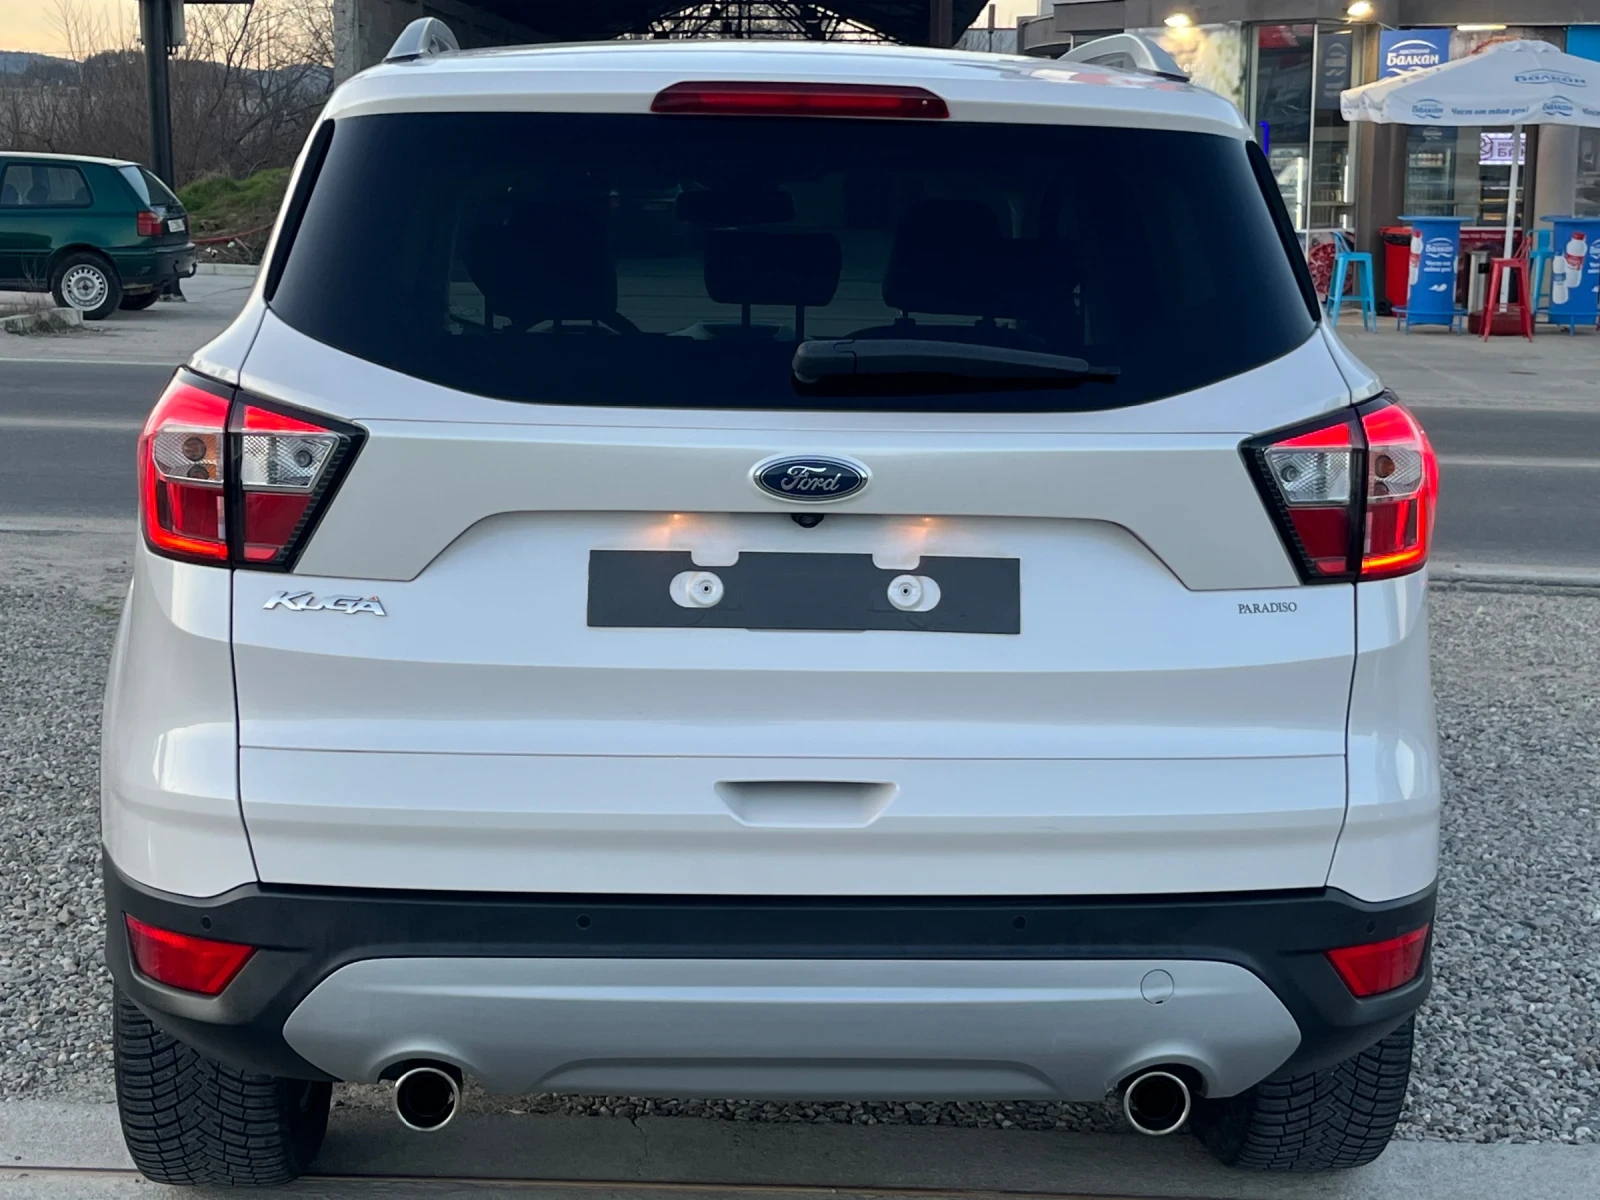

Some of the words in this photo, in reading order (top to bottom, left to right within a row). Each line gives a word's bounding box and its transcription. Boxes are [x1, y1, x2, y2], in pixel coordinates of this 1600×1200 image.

[1386, 52, 1439, 66] Балкан
[780, 465, 842, 491] Ford
[262, 590, 387, 617] KUGA
[1237, 601, 1298, 615] PARADISO
